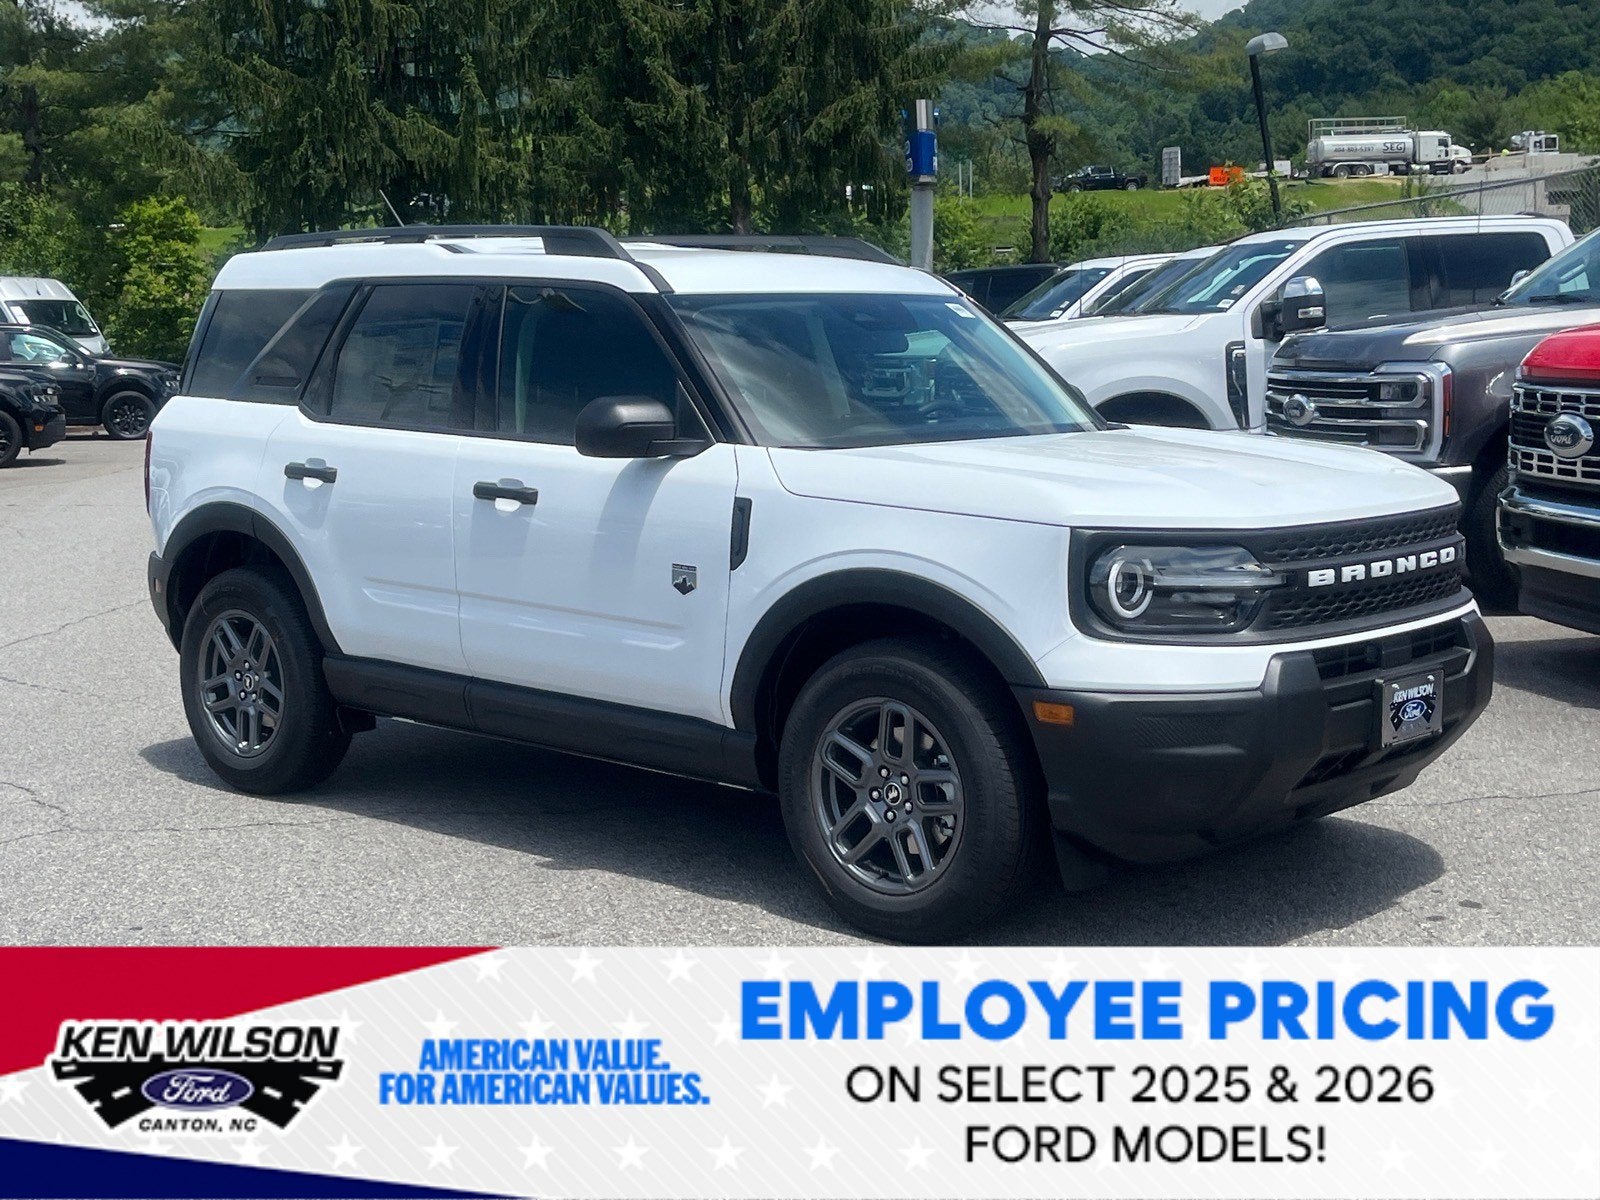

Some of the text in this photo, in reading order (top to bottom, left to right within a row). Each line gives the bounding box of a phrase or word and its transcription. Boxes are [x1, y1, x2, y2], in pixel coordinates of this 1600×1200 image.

[1383, 142, 1403, 152] SEG
[1308, 546, 1456, 588] BRONCO
[1393, 683, 1435, 703] KEN WILSON
